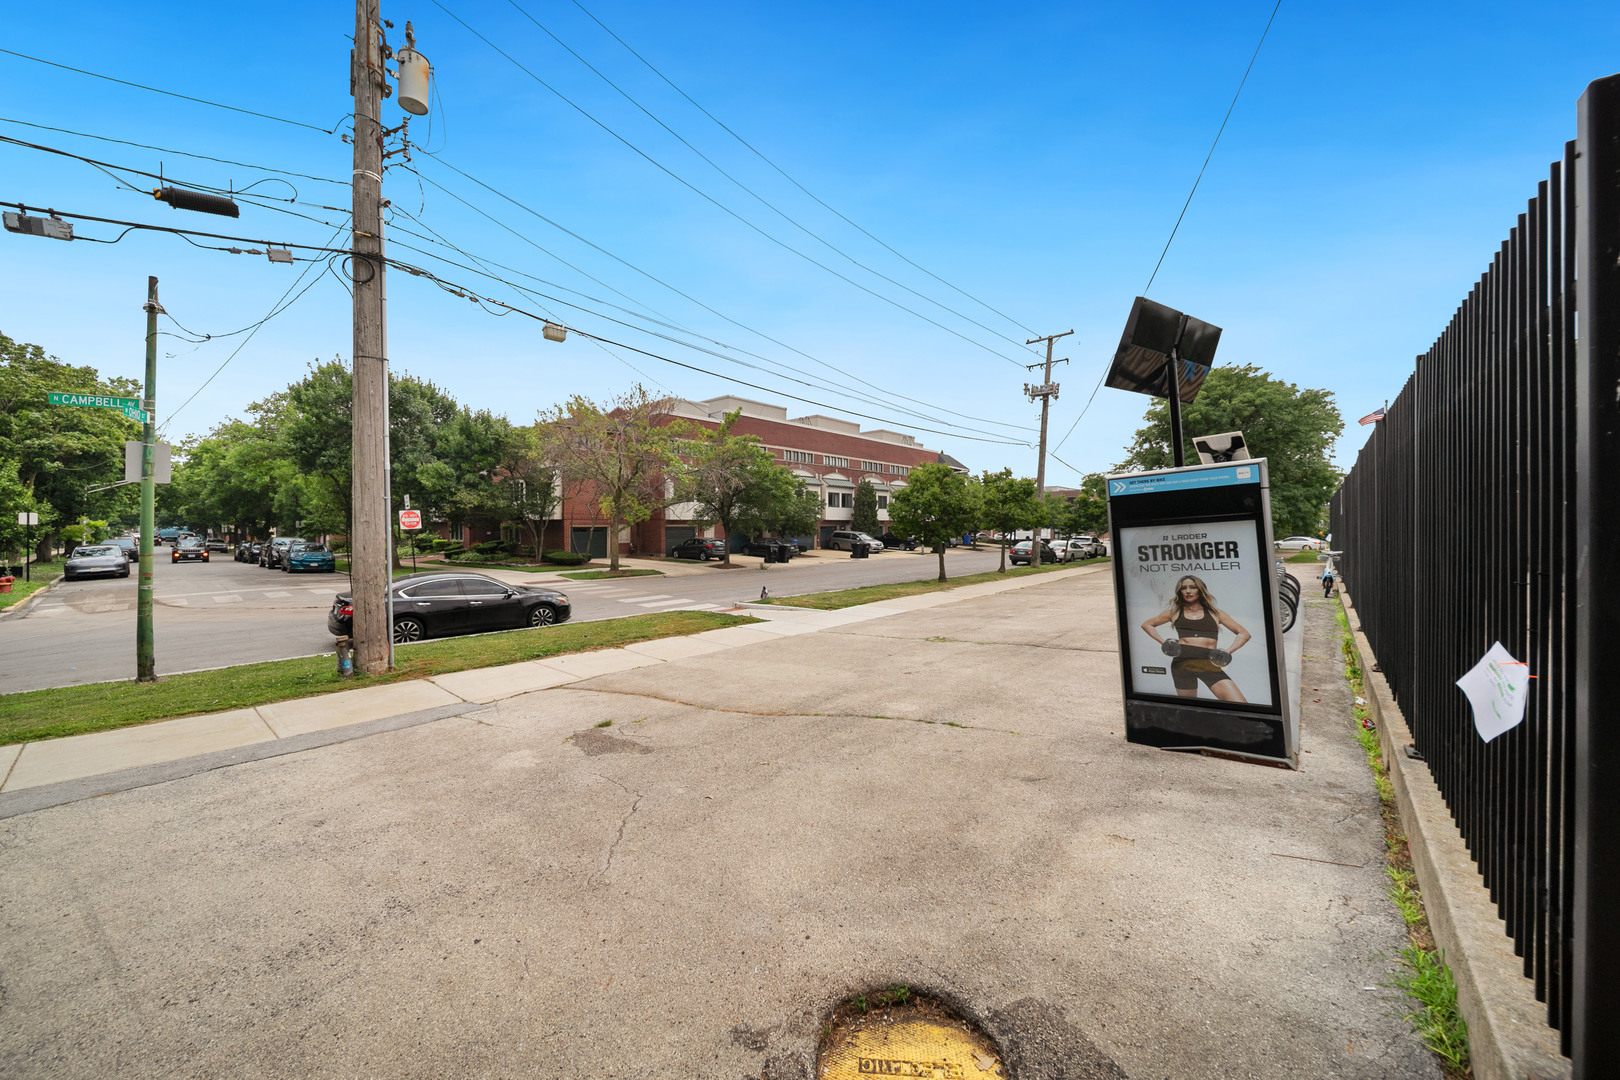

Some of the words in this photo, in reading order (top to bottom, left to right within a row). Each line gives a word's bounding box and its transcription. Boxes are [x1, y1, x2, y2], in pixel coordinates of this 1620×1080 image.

[62, 394, 123, 407] CAMPBELL
[129, 407, 140, 419] OHIO
[1172, 533, 1208, 541] LADDER
[1137, 541, 1240, 562] STRONGER
[1139, 563, 1168, 573] NOT
[1171, 561, 1241, 572] SMALLER
